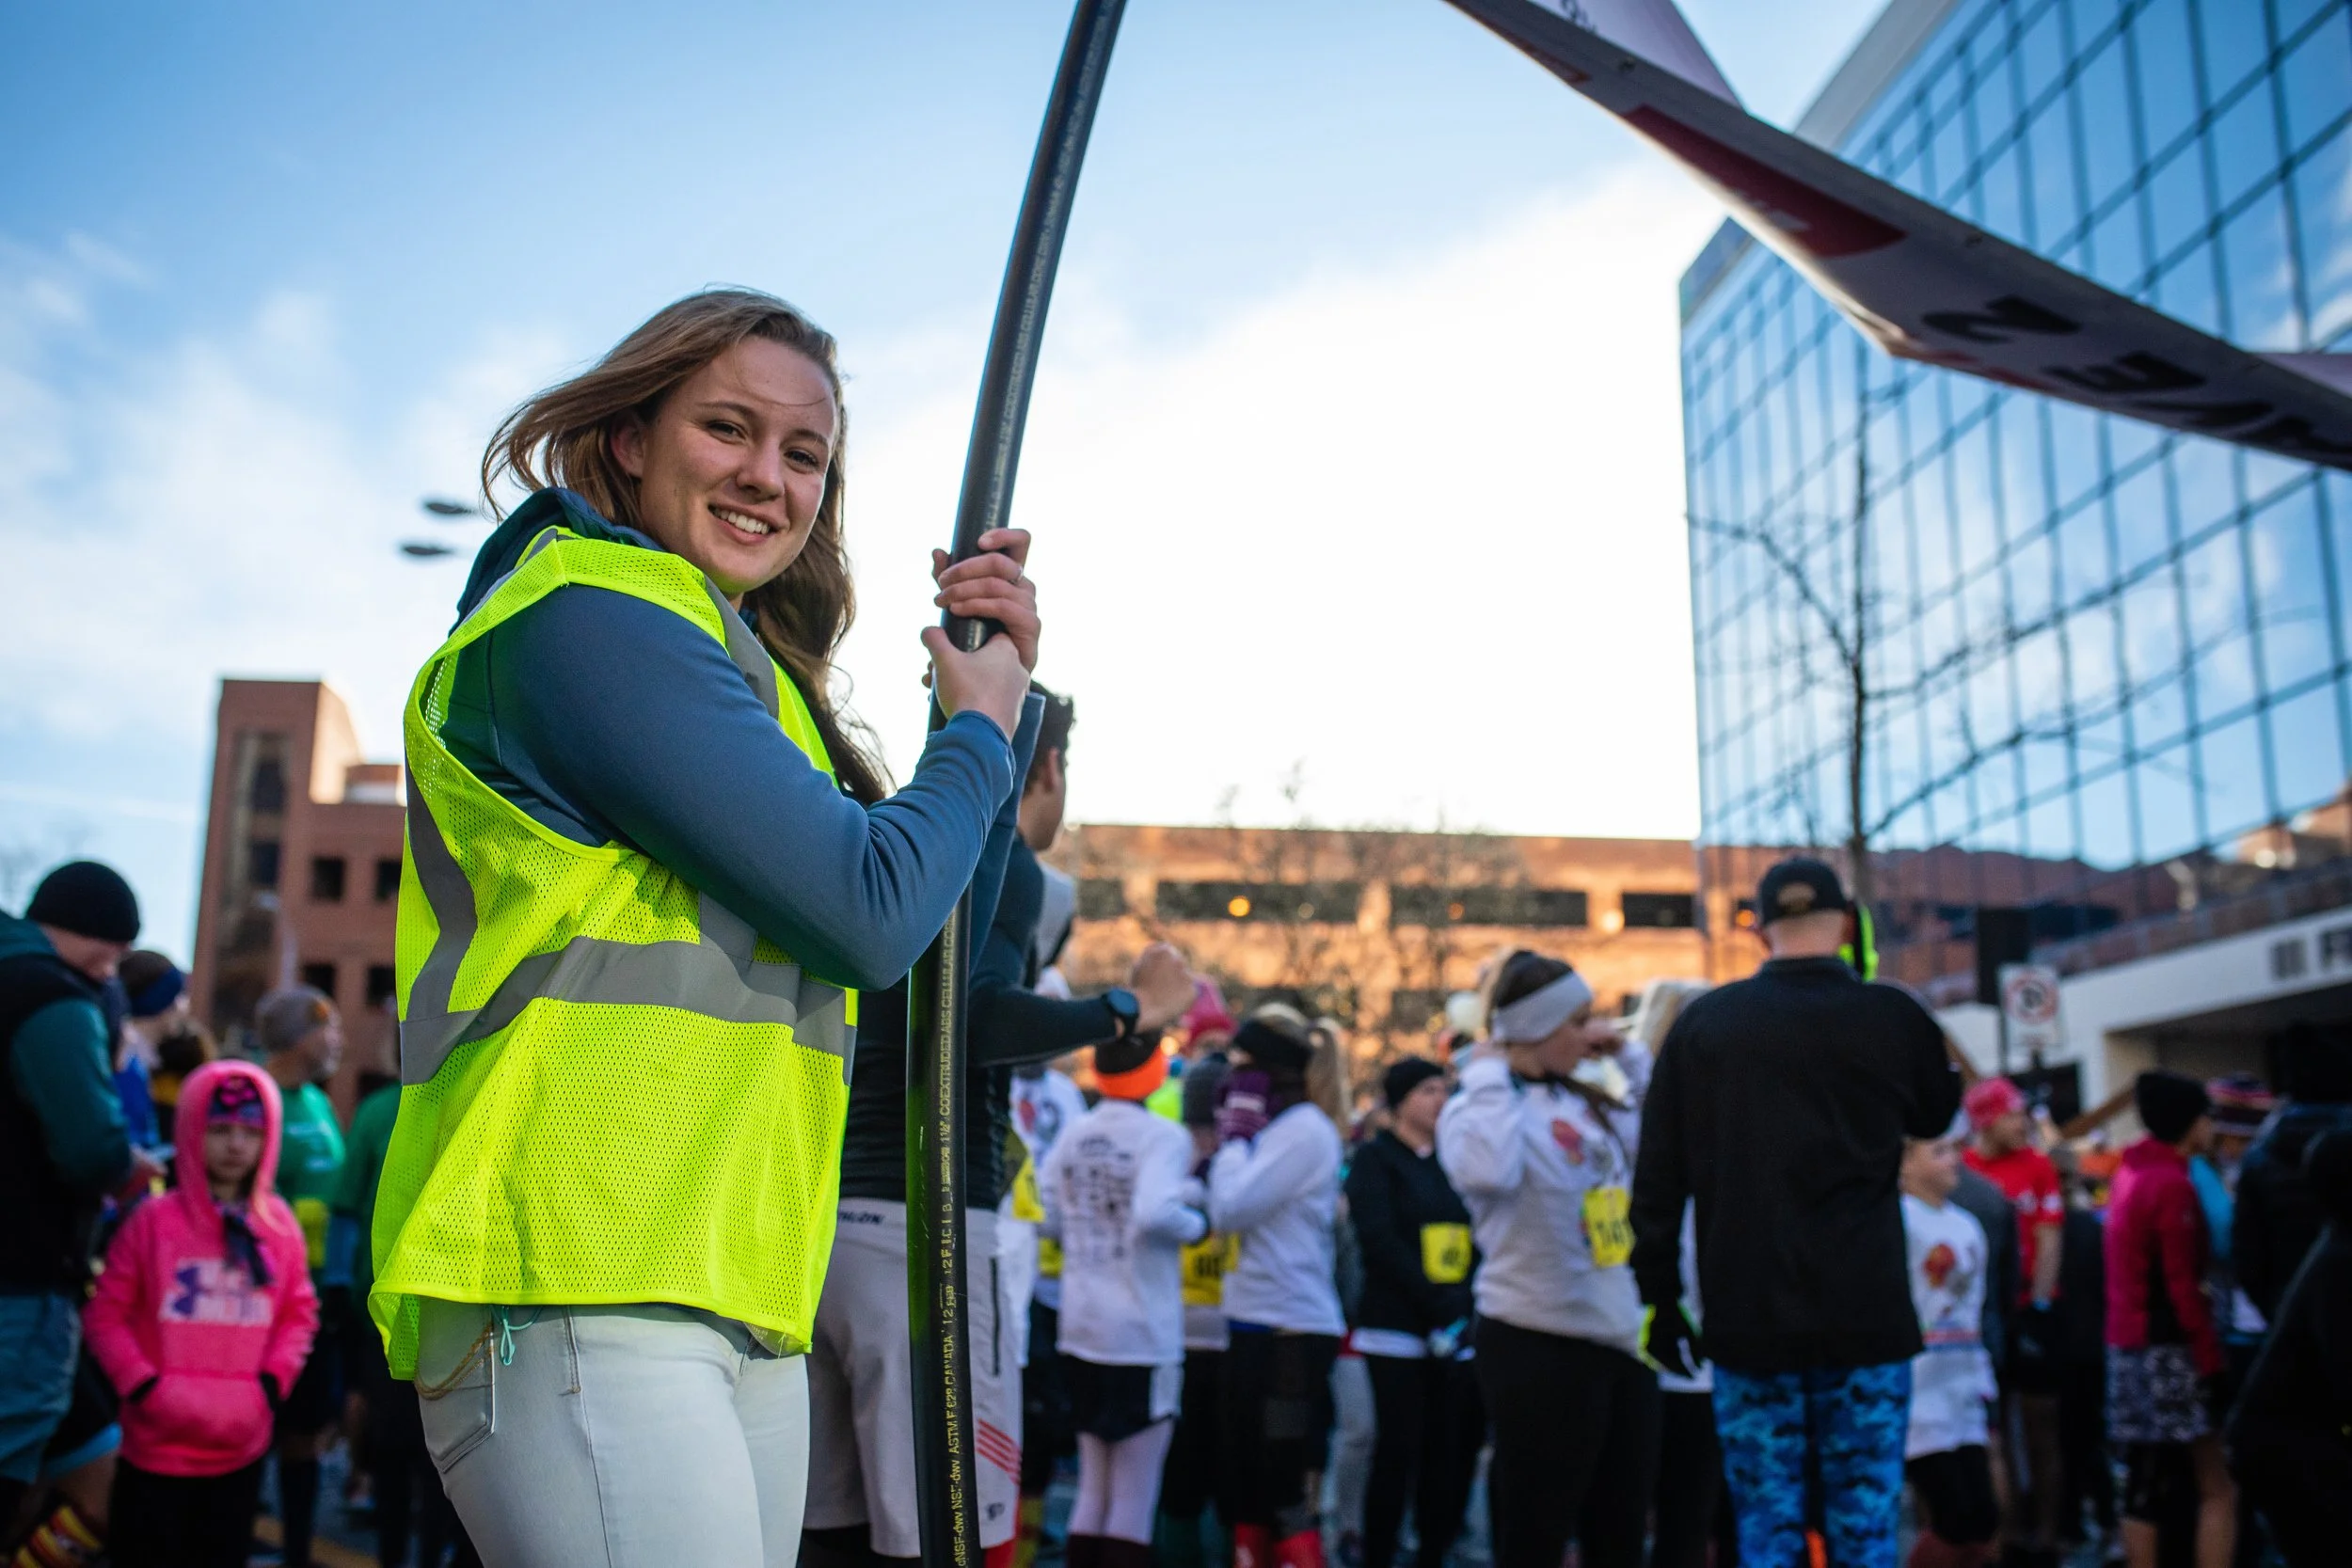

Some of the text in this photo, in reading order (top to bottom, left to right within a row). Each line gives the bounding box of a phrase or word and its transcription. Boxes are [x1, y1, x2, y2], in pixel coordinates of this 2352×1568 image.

[941, 948, 954, 1007] CELLULAR
[941, 1010, 952, 1032] ABS
[940, 1035, 951, 1117] COEXTRUDED
[943, 1335, 956, 1386] CANADA
[947, 1420, 960, 1454] ASTM
